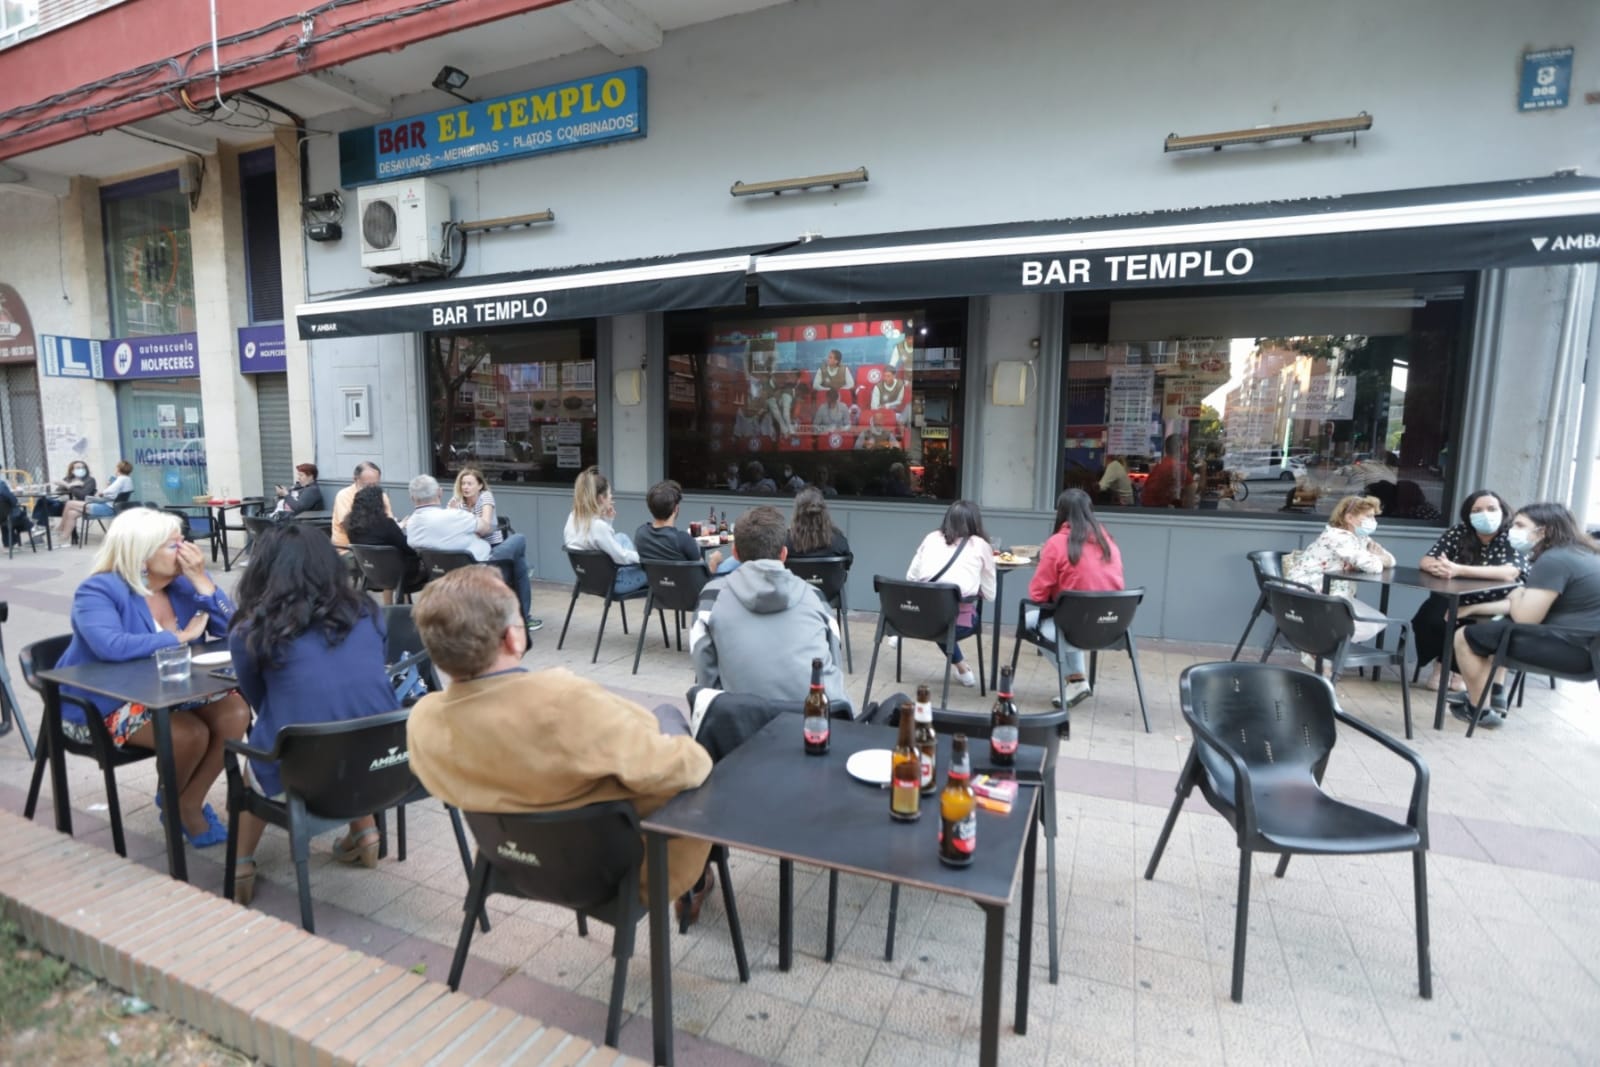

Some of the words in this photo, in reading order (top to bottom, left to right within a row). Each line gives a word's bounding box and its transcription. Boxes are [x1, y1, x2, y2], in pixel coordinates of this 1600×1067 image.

[378, 120, 427, 155] BAR
[437, 113, 476, 143] EL
[487, 77, 627, 132] TEMPLO
[379, 153, 433, 175] DESAYUNOS
[443, 140, 500, 161] MERIENDAS
[513, 130, 553, 149] PLATOS
[556, 114, 634, 141] COMBINADOS
[1022, 259, 1091, 286] BAR
[1105, 248, 1254, 281] TEMPLO
[432, 306, 468, 326] BAR
[474, 297, 548, 322] TEMPLO
[61, 339, 87, 369] L
[139, 339, 194, 354] autoescuela
[140, 356, 195, 372] MOLPECERES
[132, 424, 205, 439] autoescuel
